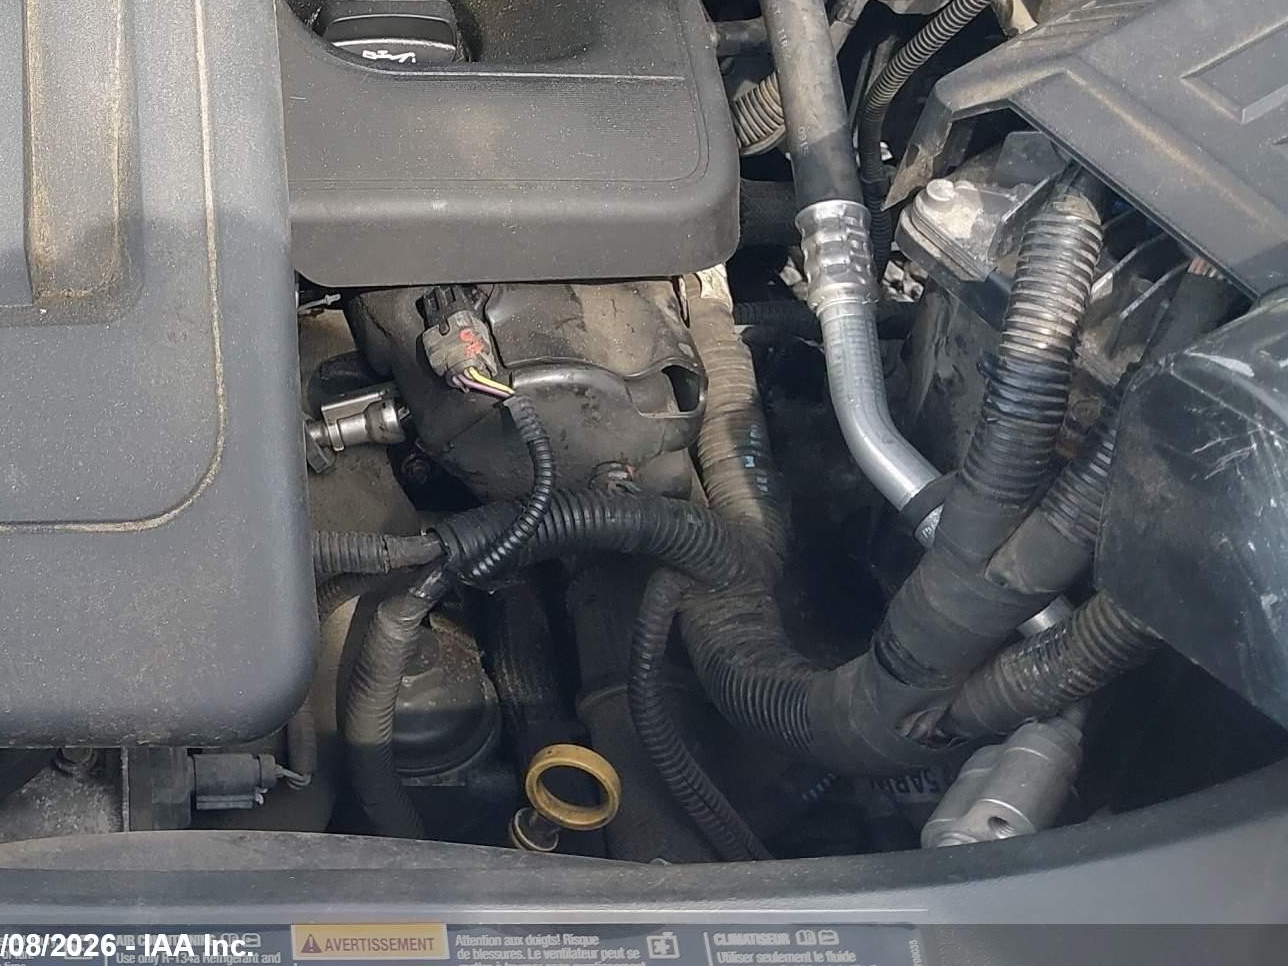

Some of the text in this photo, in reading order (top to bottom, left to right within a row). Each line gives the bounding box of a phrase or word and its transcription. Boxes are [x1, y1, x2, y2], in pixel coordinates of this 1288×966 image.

[324, 937, 435, 952] AVERTISSEMENT
[455, 934, 600, 948] Attention aux doigts! Risque
[115, 952, 136, 964] Use
[261, 951, 282, 964] and
[456, 947, 641, 962] de blessures. Le ventilateur peut se
[716, 950, 857, 964] Utiliser seulement le fluide
